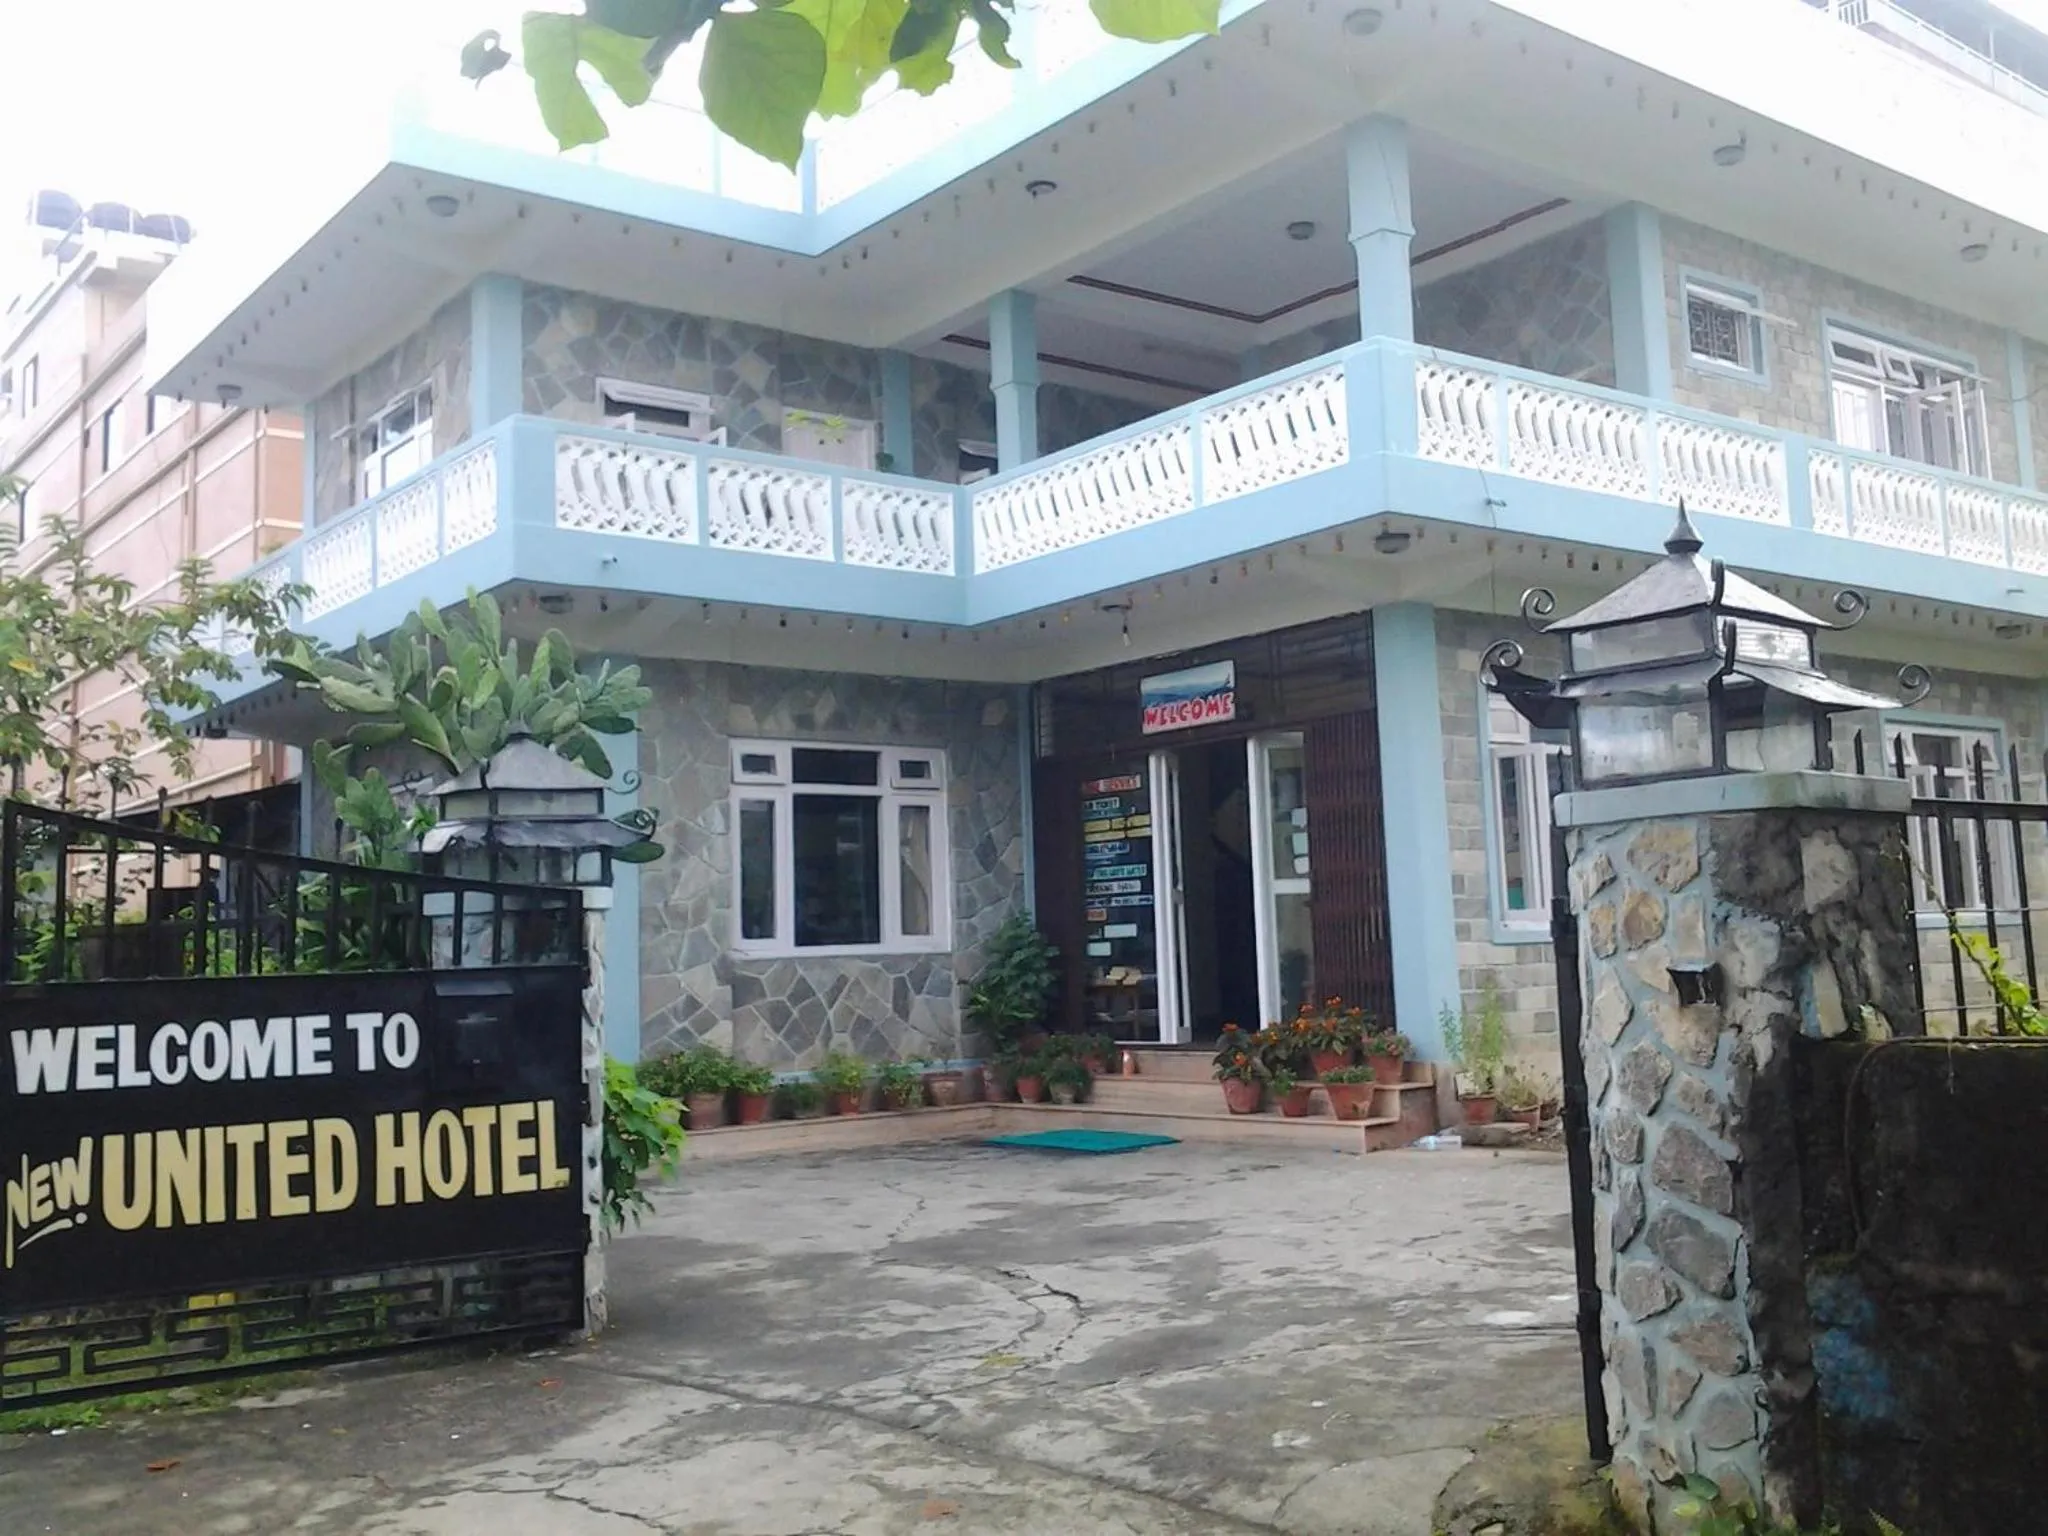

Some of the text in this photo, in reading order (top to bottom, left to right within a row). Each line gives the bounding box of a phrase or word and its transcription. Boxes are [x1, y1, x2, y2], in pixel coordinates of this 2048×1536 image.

[1143, 695, 1231, 726] WELCOME
[10, 1012, 420, 1095] WELCOME TO
[102, 1118, 359, 1230] UNITED
[374, 1099, 571, 1207] HOTEL
